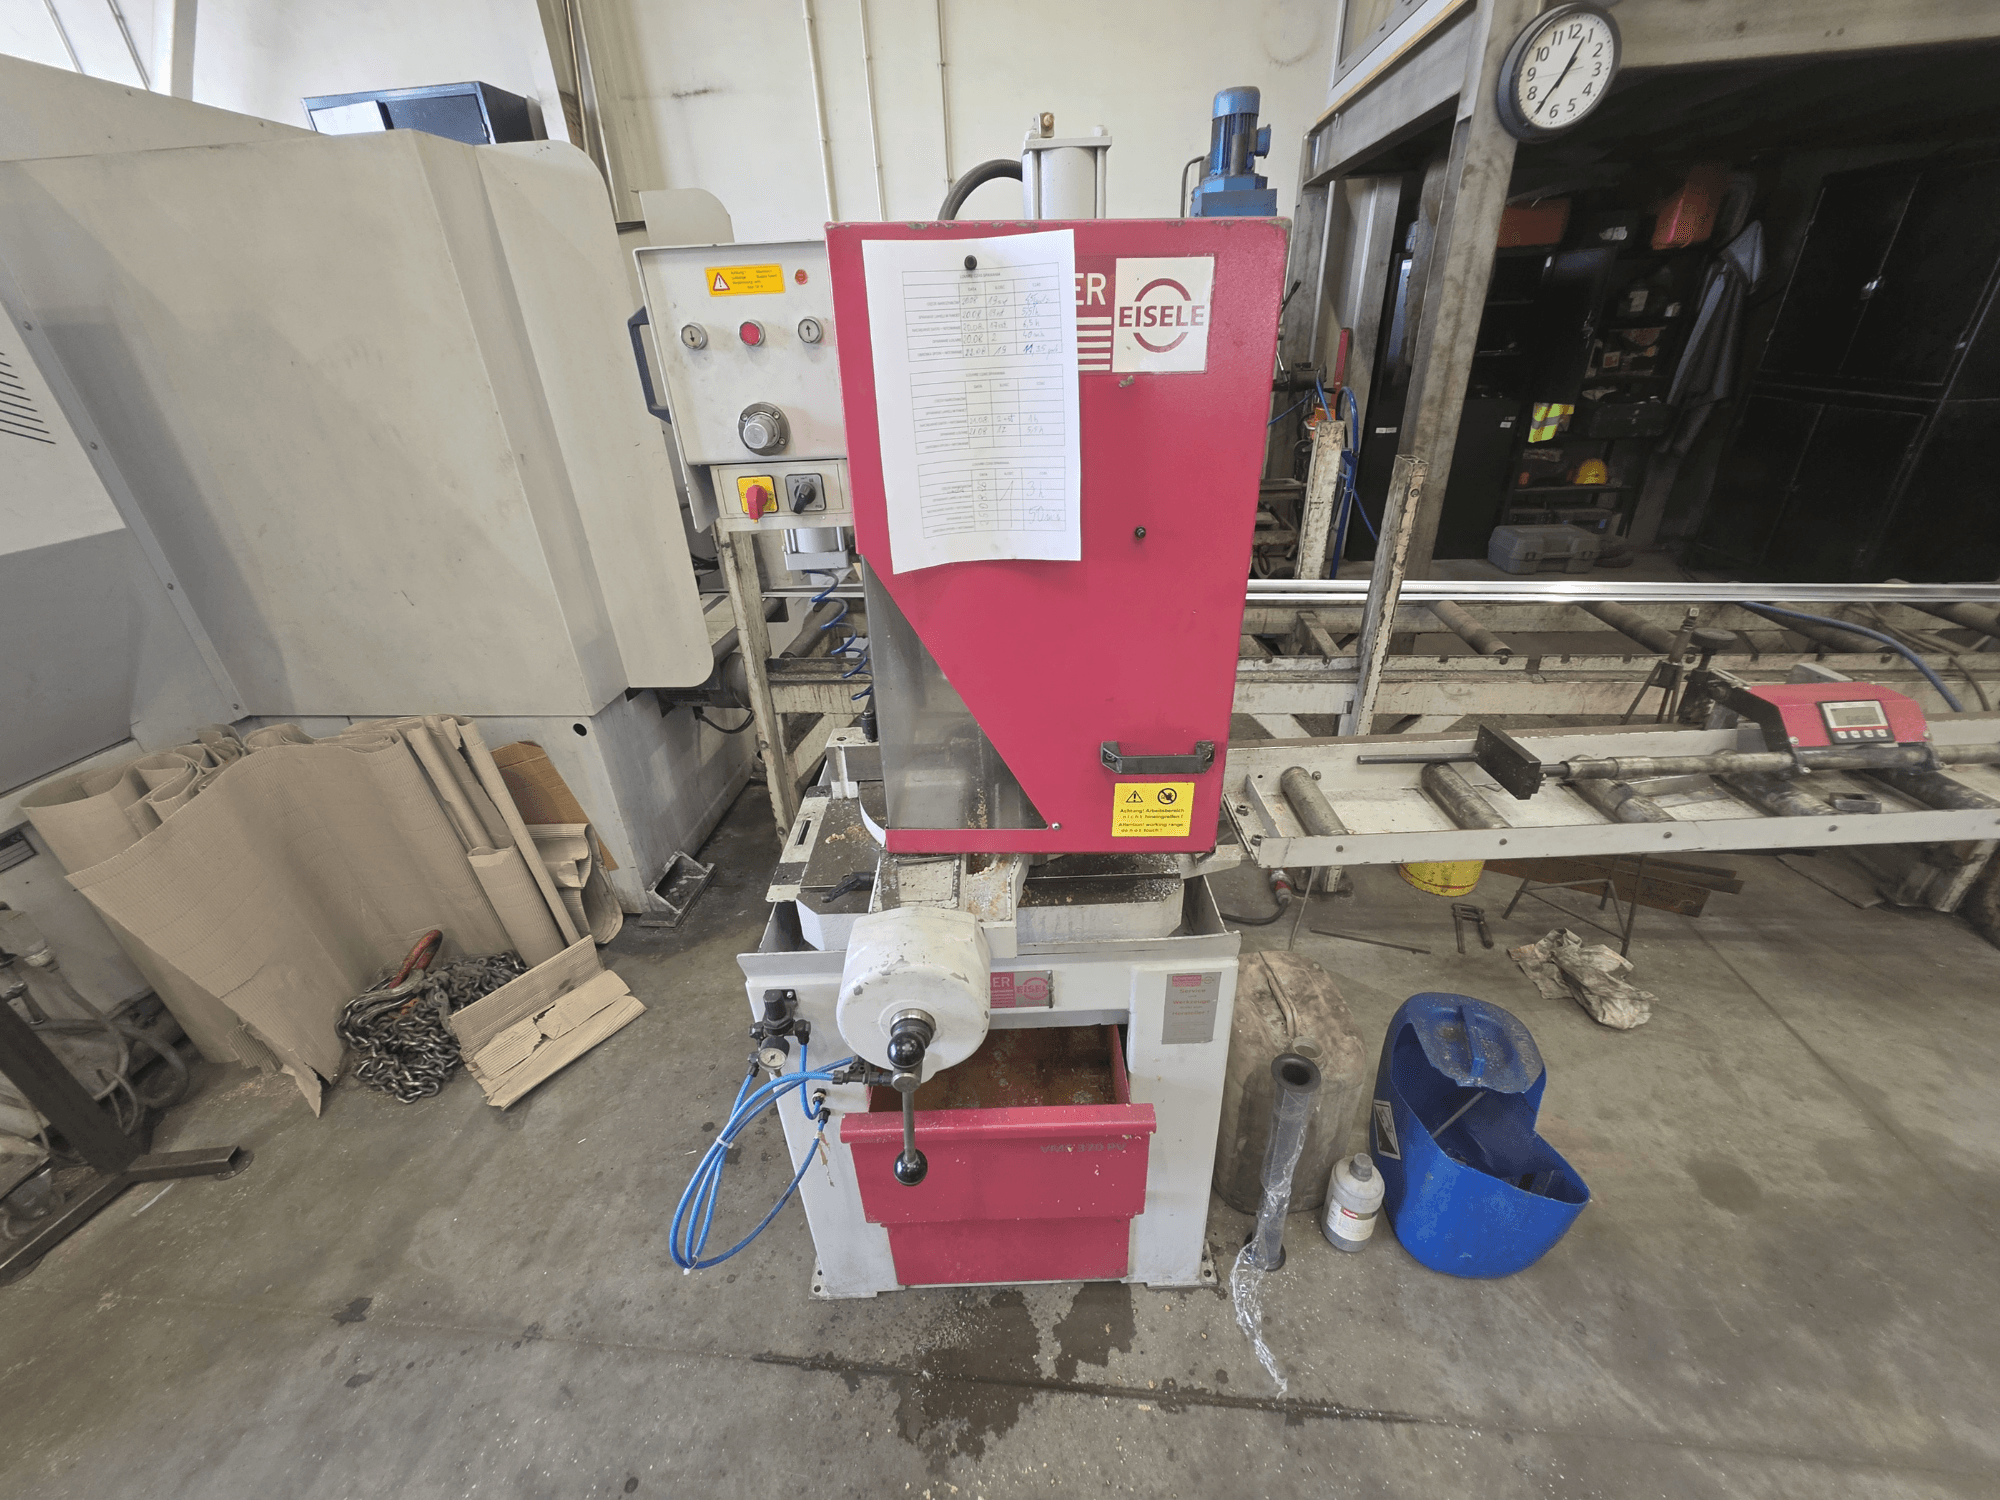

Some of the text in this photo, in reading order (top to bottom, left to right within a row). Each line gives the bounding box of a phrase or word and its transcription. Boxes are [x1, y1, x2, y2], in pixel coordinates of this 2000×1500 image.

[1552, 30, 1564, 46] 11
[1568, 23, 1583, 40] 12
[1588, 27, 1595, 44] 1
[1535, 46, 1550, 62] 10
[1592, 42, 1604, 58] 2
[1526, 67, 1537, 83] 9
[1592, 61, 1603, 77] 3
[1526, 85, 1538, 101] 8
[1582, 81, 1594, 97] 4
[1549, 103, 1560, 119] 6
[1566, 97, 1578, 113] 5
[1119, 304, 1205, 328] EISELE
